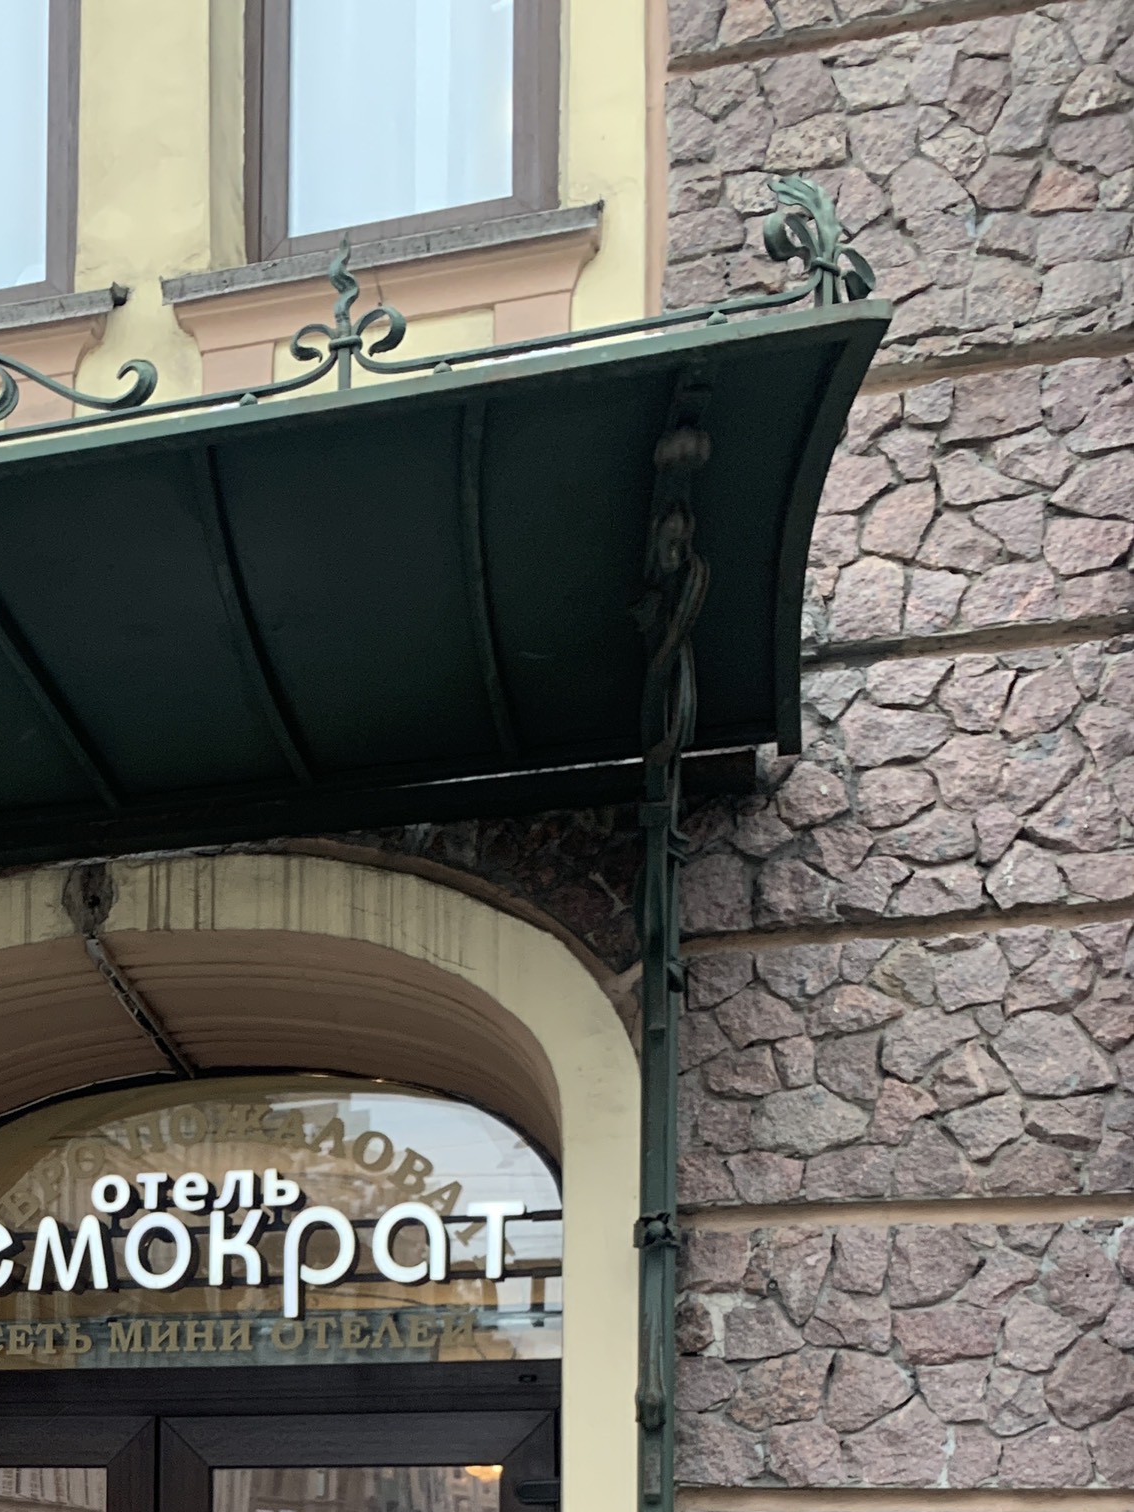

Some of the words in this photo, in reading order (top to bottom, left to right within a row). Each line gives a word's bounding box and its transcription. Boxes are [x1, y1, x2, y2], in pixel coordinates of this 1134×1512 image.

[91, 1168, 301, 1213] отель
[124, 1102, 516, 1272] ПОЖАЛОВА
[108, 1319, 254, 1354] МИНИ
[270, 1306, 477, 1350] ОТЕЛЕЙ
